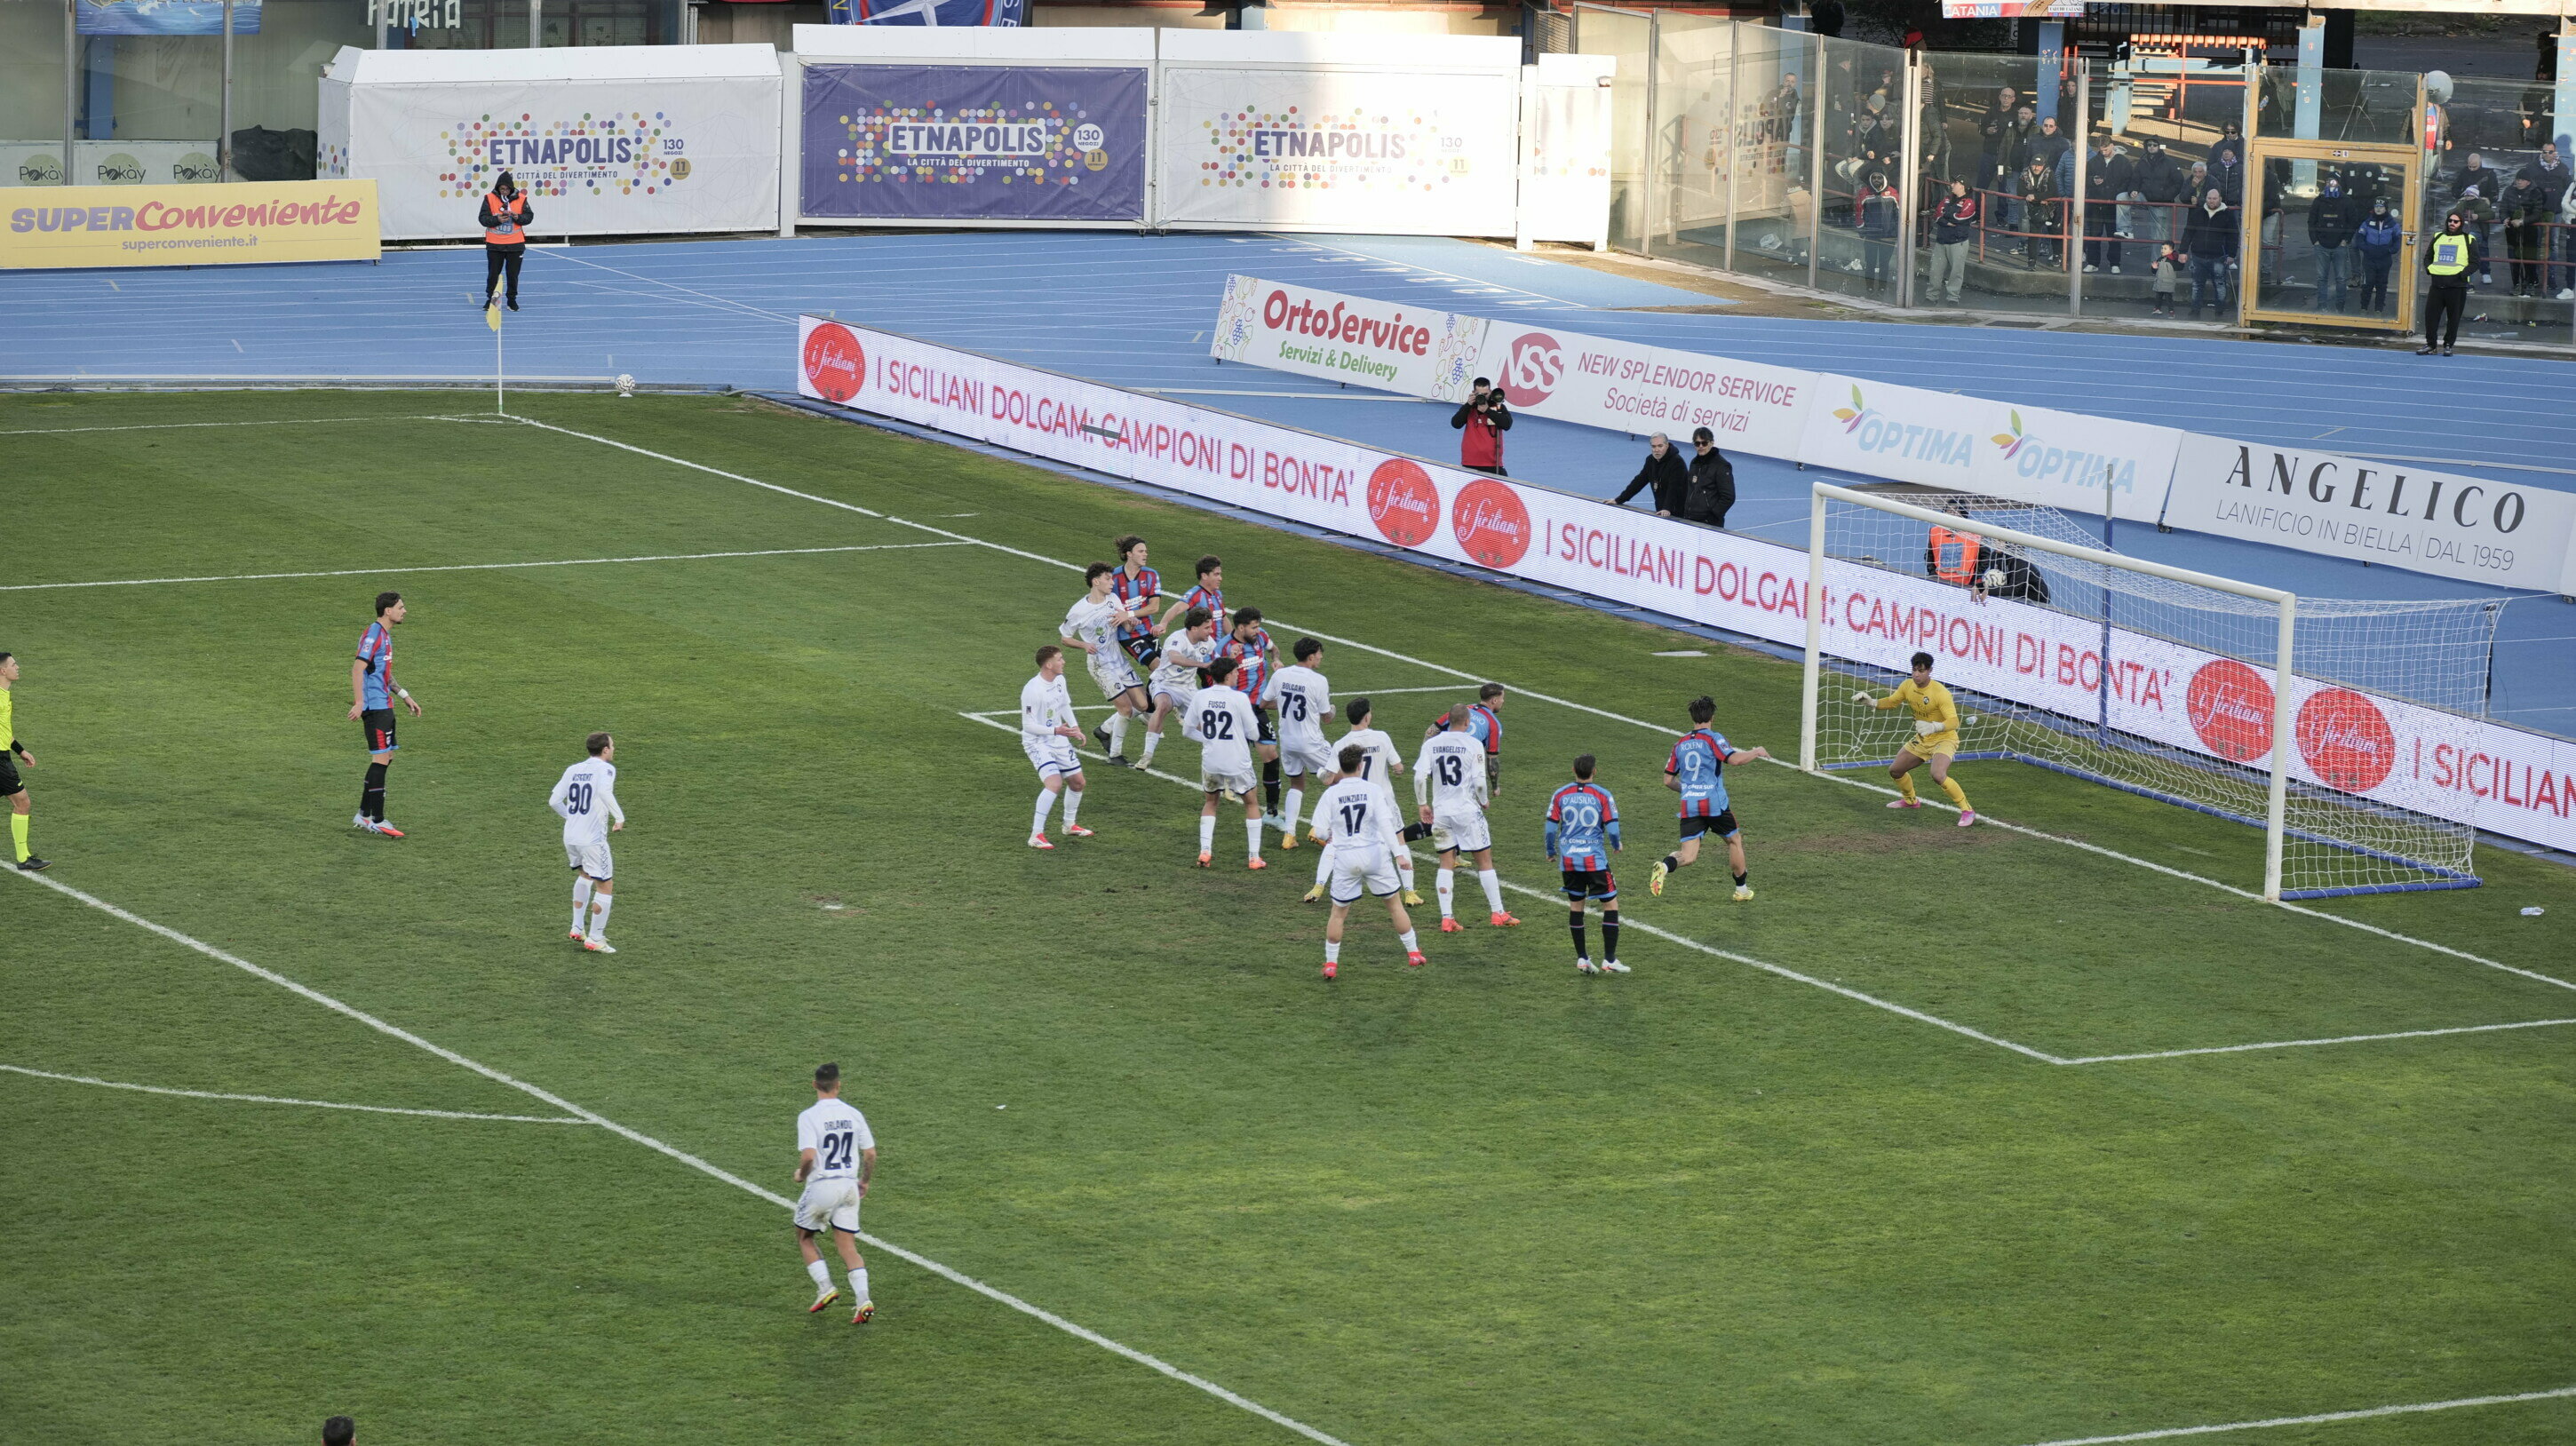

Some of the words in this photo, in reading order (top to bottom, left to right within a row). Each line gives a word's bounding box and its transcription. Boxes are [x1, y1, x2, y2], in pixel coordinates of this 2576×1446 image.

[1944, 5, 1998, 17] CATANIA
[663, 139, 684, 150] 130
[892, 125, 1044, 152] ETNAPOLIS
[1077, 130, 1101, 140] 130
[1254, 131, 1406, 159] ETNAPOLIS
[1441, 137, 1463, 147] 130
[489, 137, 632, 166] ETNAPOLIS
[675, 162, 686, 171] 11
[920, 156, 947, 166] CITTÀ
[967, 159, 1030, 168] DIVERTIMENTO
[1090, 152, 1101, 163] 11
[1453, 159, 1465, 171] 11
[517, 170, 541, 180] CITTÀ
[561, 171, 618, 179] DIVERTIMENTO
[1284, 163, 1308, 171] CITTÀ
[1330, 165, 1392, 174] DIVERTIMENTO
[122, 234, 258, 253] superconveniente.it
[1263, 290, 1430, 356] OrtoService
[1279, 339, 1324, 366] Servizi
[1325, 349, 1336, 368] &
[1340, 351, 1398, 383] Delivery
[1578, 351, 1620, 376] NEW
[1620, 359, 1716, 393] SPLENDOR
[1718, 375, 1797, 408] SERVICE
[1604, 387, 1666, 422] Società
[1672, 399, 1689, 422] di
[1691, 409, 1751, 433] servizi
[877, 356, 882, 389] I
[889, 360, 984, 416] SICILIANI
[1101, 413, 1221, 474] CAMPIONI
[1231, 442, 1254, 483] DI
[1265, 451, 1356, 507] BONTA'
[1858, 419, 1974, 468] OPTIMA
[2017, 444, 2136, 494] OPTIMA
[2225, 445, 2525, 534] ANGELICO
[2216, 499, 2313, 536] LANIFICIO
[2318, 518, 2338, 543] IN
[2343, 523, 2413, 555] BIELLA
[2425, 536, 2466, 565] DAL
[2472, 544, 2515, 571] 1959
[1546, 519, 1551, 556] I
[1561, 522, 1685, 590] SICILIANI
[1847, 592, 2003, 668] CAMPIONI
[2016, 632, 2044, 679] DI
[1281, 691, 1307, 722] 73
[1202, 710, 1233, 740] 82
[1432, 745, 1467, 754] EVANGELISTI
[1435, 755, 1463, 786] 13
[1685, 751, 1702, 782] 9
[568, 783, 592, 815] 90
[1339, 793, 1368, 805] NUNZIATA
[1340, 803, 1367, 838] 17
[1562, 806, 1599, 836] 99
[823, 1132, 854, 1171] 24
